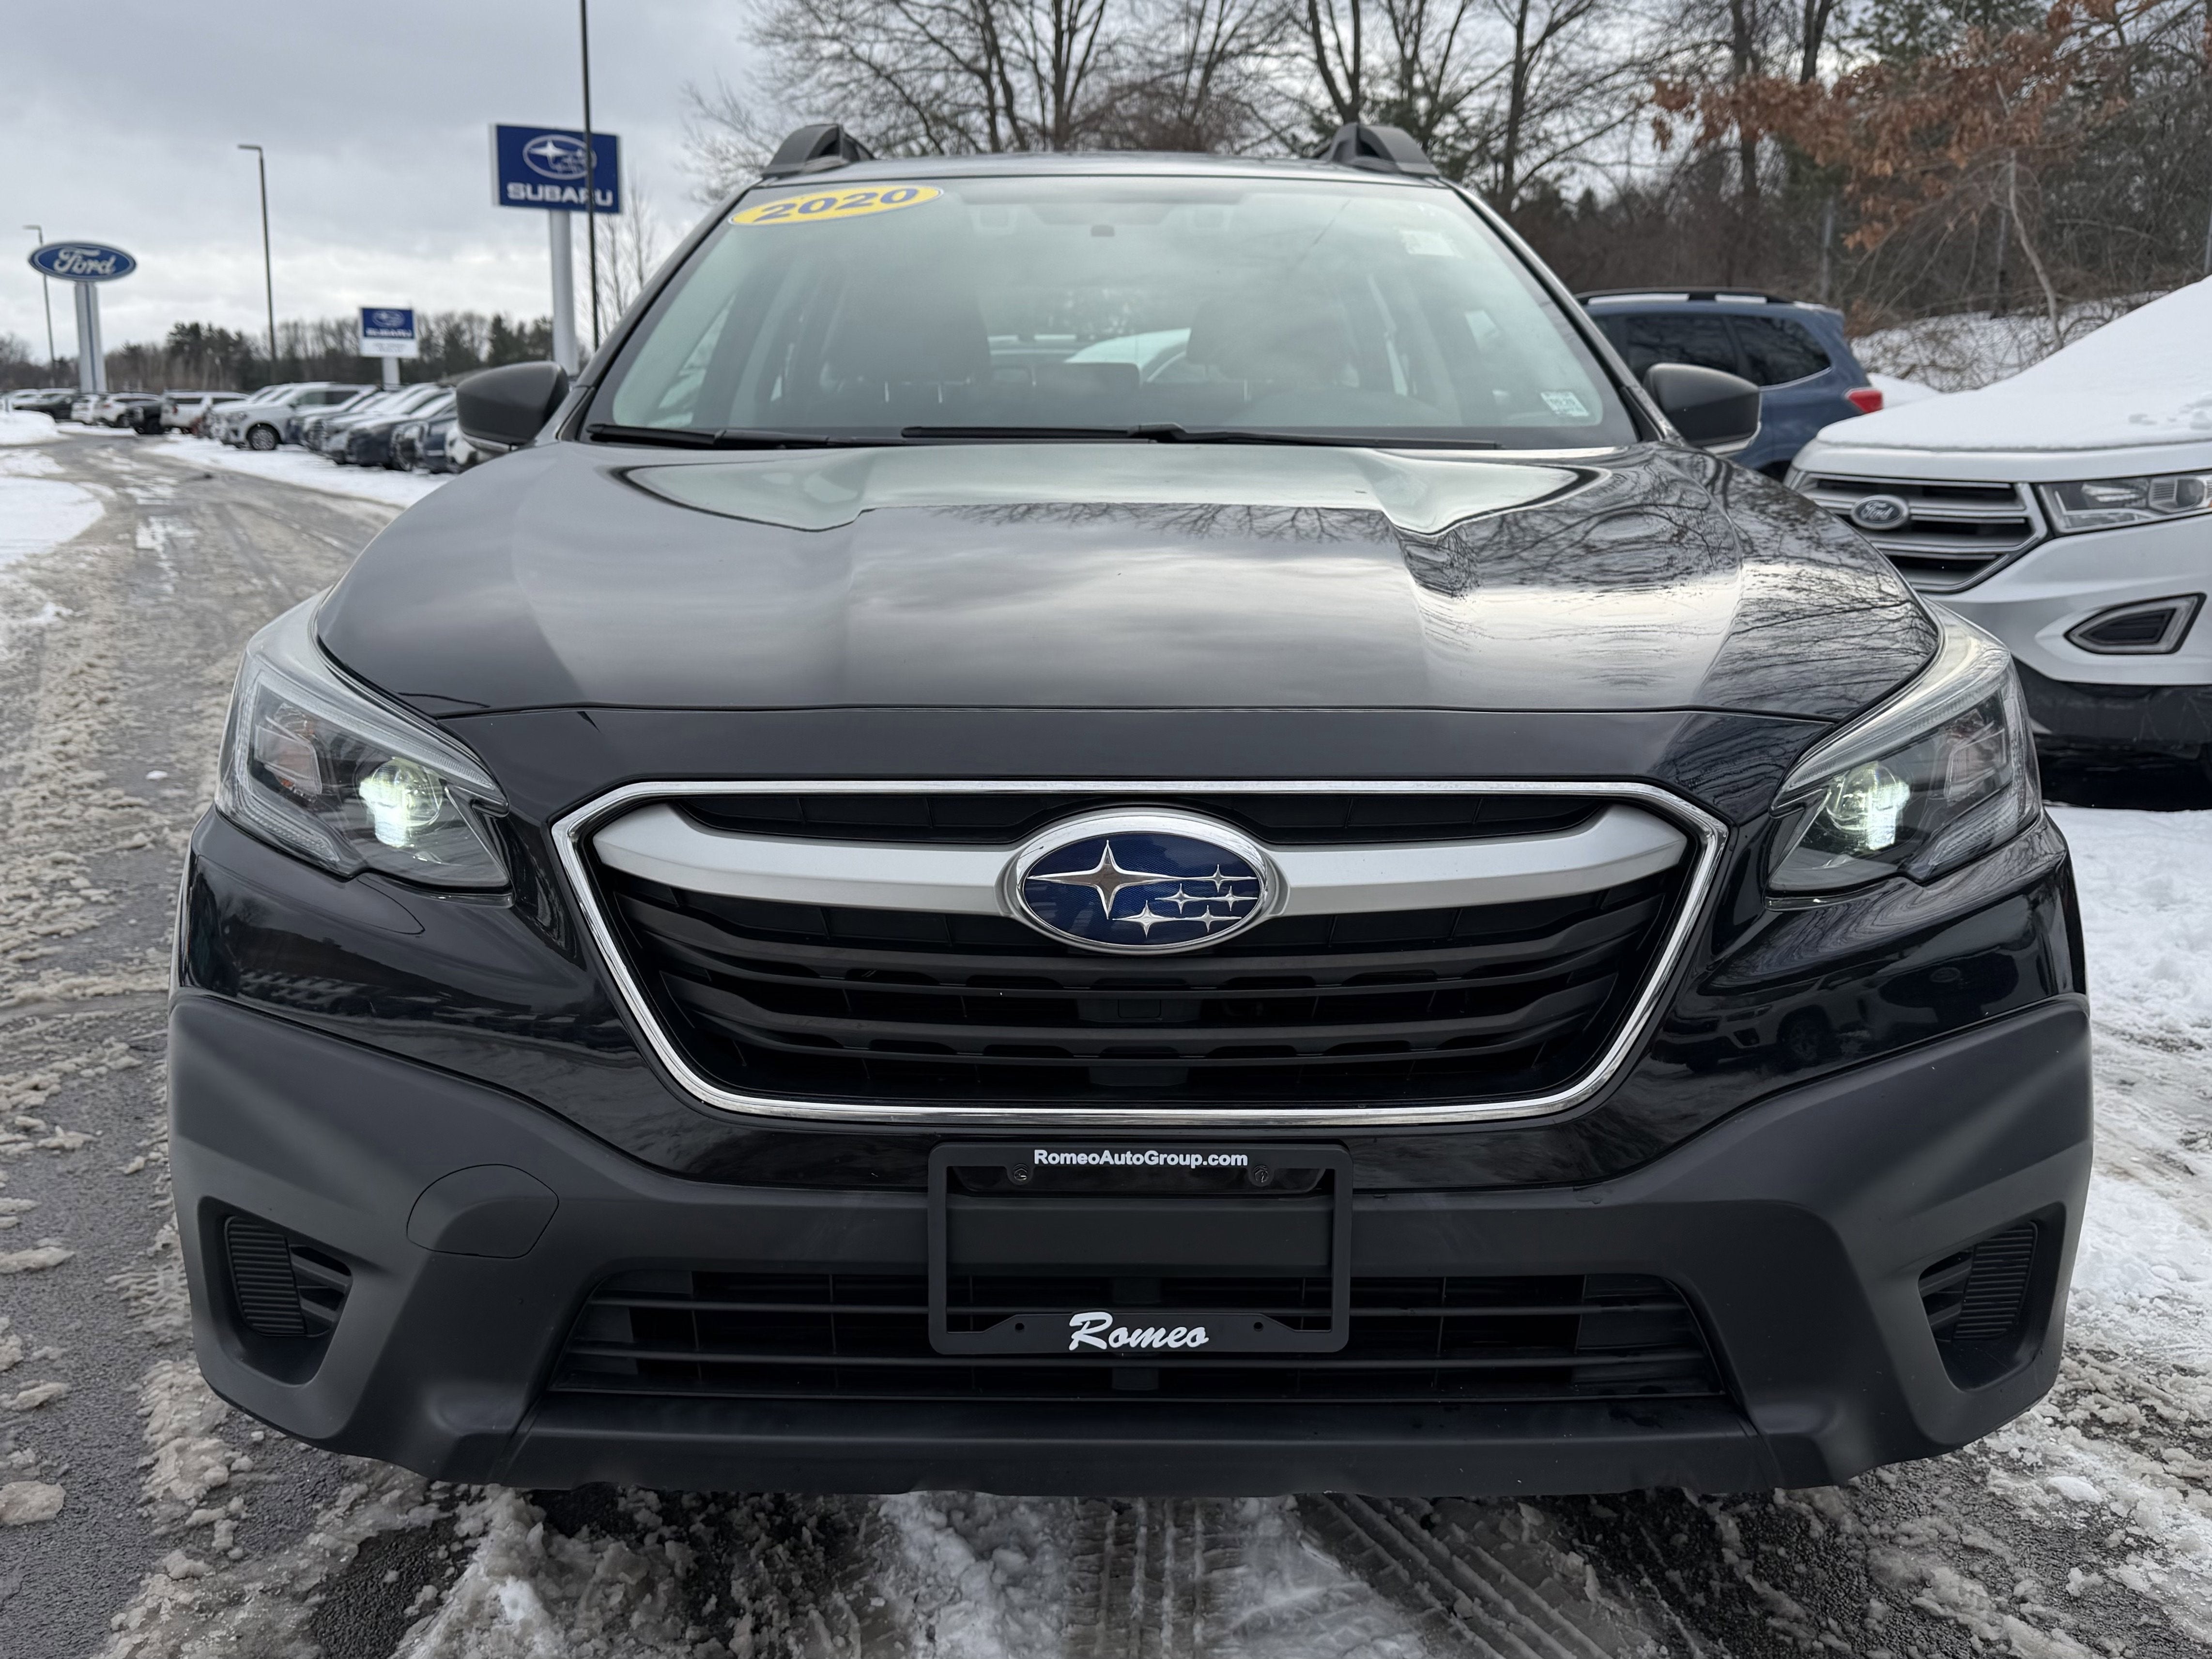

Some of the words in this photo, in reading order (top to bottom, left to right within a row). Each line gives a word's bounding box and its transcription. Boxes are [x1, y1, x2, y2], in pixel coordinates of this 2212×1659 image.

[753, 188, 919, 223] 2020
[54, 247, 116, 275] Ford
[1860, 501, 1894, 521] Ford
[1034, 1149, 1248, 1168] RomeoAutoGroup.com
[1069, 1311, 1210, 1351] Romeo
